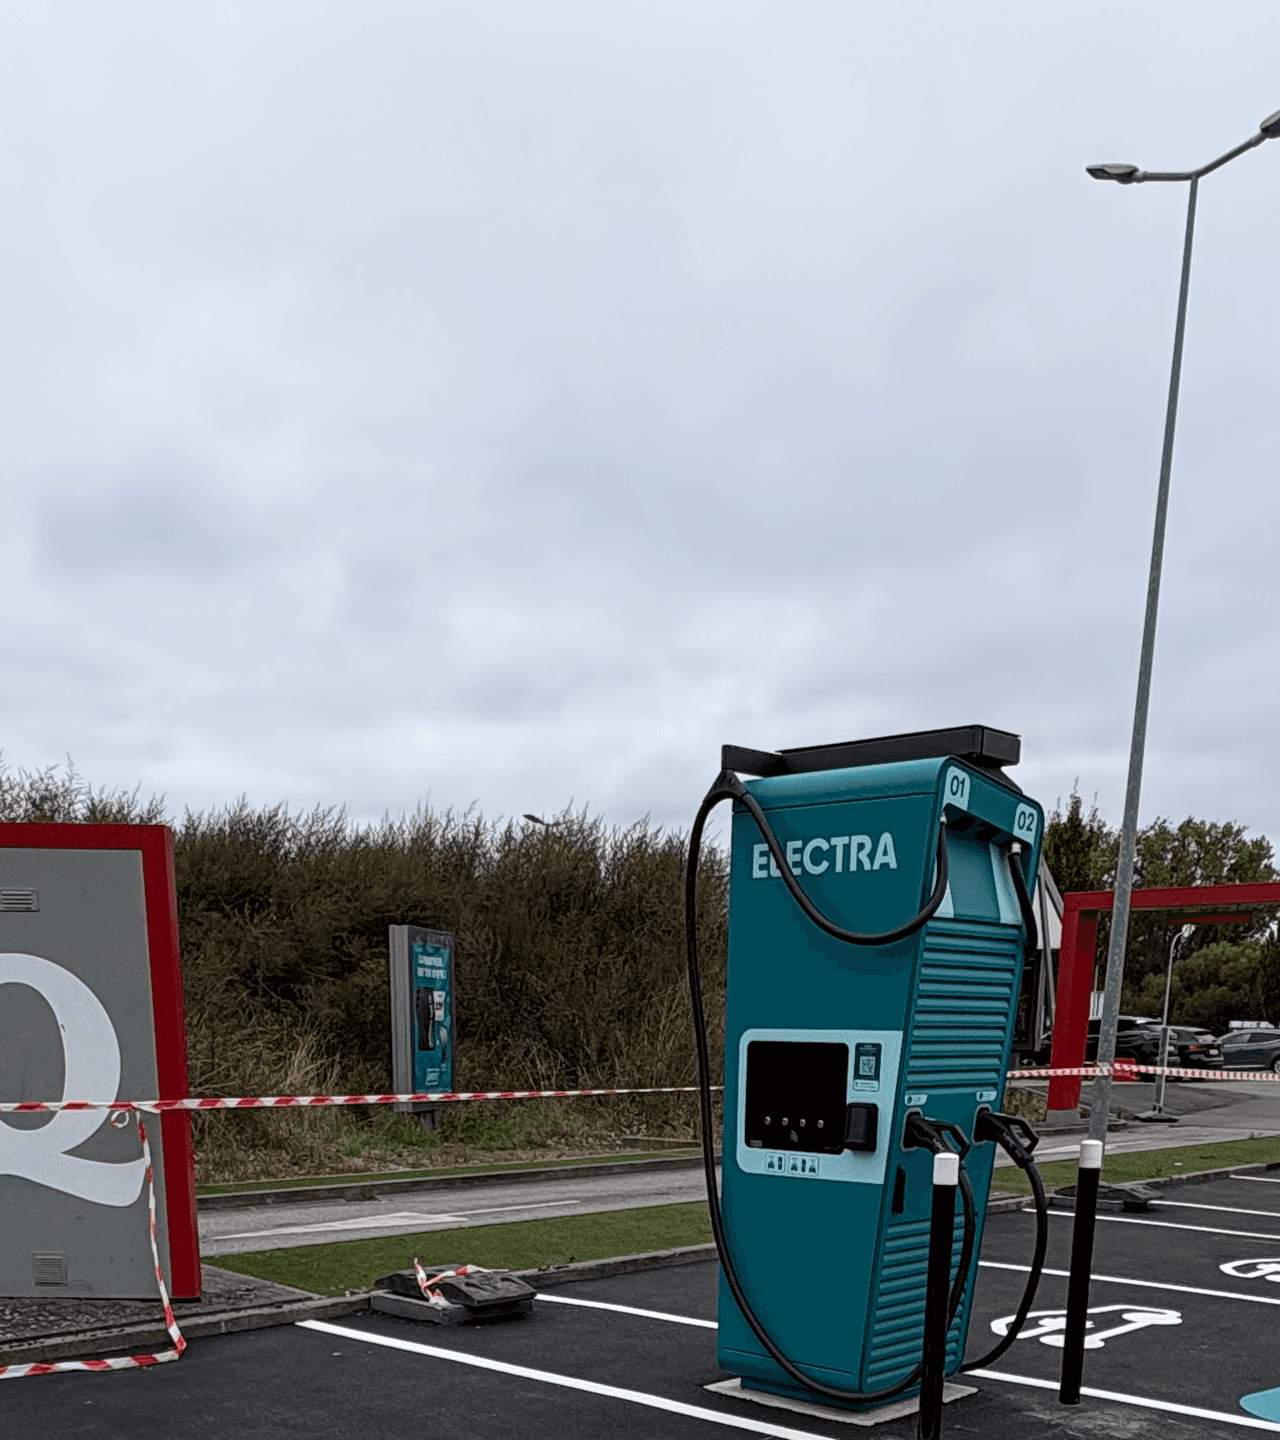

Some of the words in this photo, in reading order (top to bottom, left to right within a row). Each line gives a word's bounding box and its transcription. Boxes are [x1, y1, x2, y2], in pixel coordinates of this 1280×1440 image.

[950, 775, 966, 798] 01
[1017, 811, 1035, 832] 02
[752, 832, 898, 879] ELECTRA
